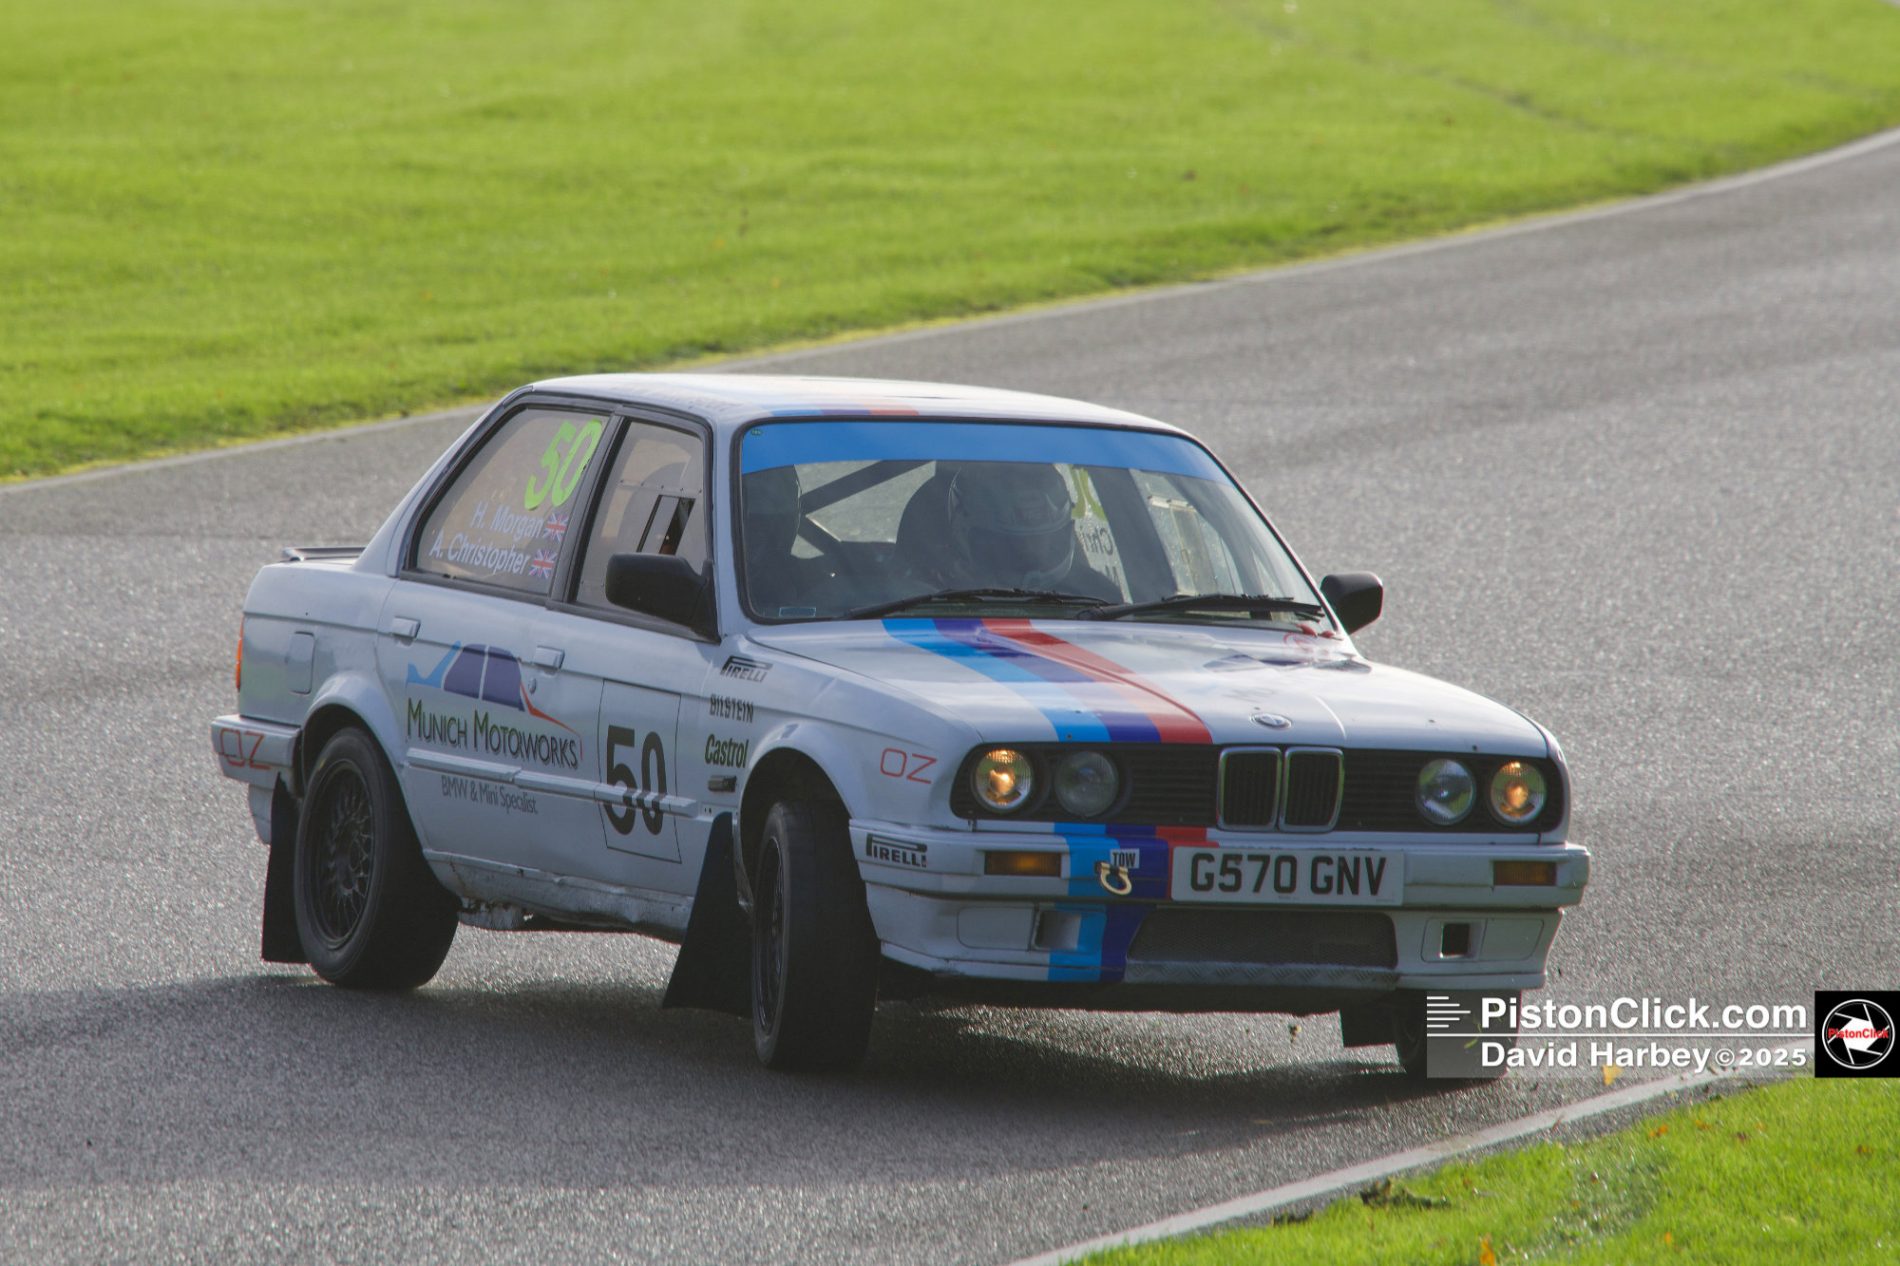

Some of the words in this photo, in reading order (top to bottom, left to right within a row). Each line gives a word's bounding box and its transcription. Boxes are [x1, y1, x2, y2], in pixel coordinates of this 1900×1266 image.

[524, 418, 602, 511] 50
[470, 501, 487, 529] H.
[490, 504, 544, 541] Morgan
[429, 529, 443, 558] A.
[448, 531, 531, 575] Christopher
[720, 655, 773, 683] PIRELLI
[407, 697, 468, 749] MUNICH
[709, 694, 754, 723] BILSTEIN
[219, 728, 272, 770] OZ
[705, 733, 749, 769] Castrol
[880, 747, 937, 784] OZ
[441, 774, 468, 800] BMW
[470, 780, 479, 803] &
[479, 781, 499, 806] Mini
[500, 785, 539, 815] Specialist
[603, 725, 667, 836] 50
[866, 832, 928, 868] PIRELLI
[1112, 852, 1136, 868] TOW
[1190, 852, 1298, 893] G570
[1310, 855, 1388, 897] GNV
